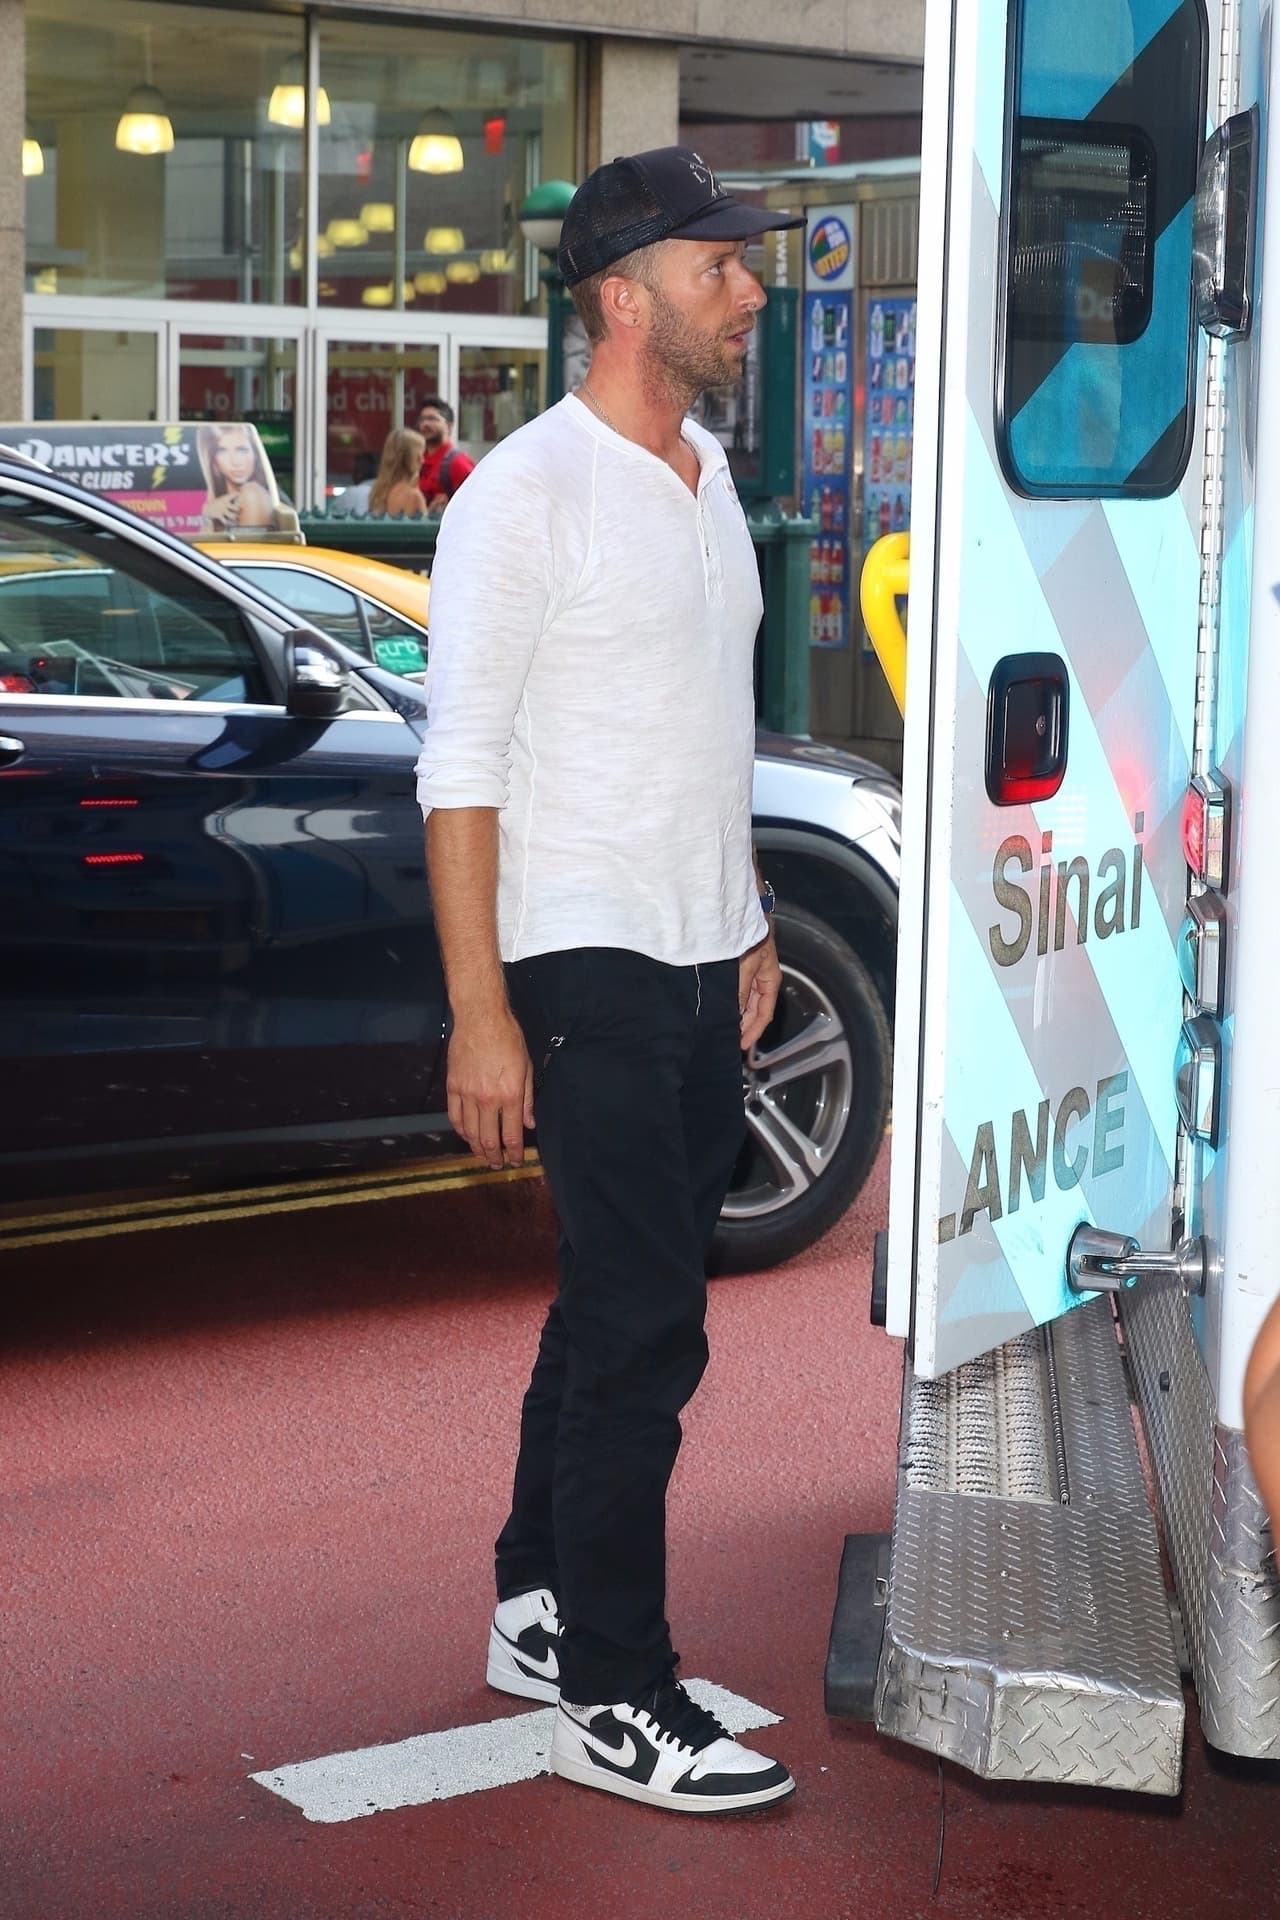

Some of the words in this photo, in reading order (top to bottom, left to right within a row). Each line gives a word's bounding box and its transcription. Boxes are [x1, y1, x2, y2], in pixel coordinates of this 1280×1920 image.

[80, 470, 135, 490] CLUBS
[375, 640, 419, 657] curb
[988, 811, 1145, 968] Sinai
